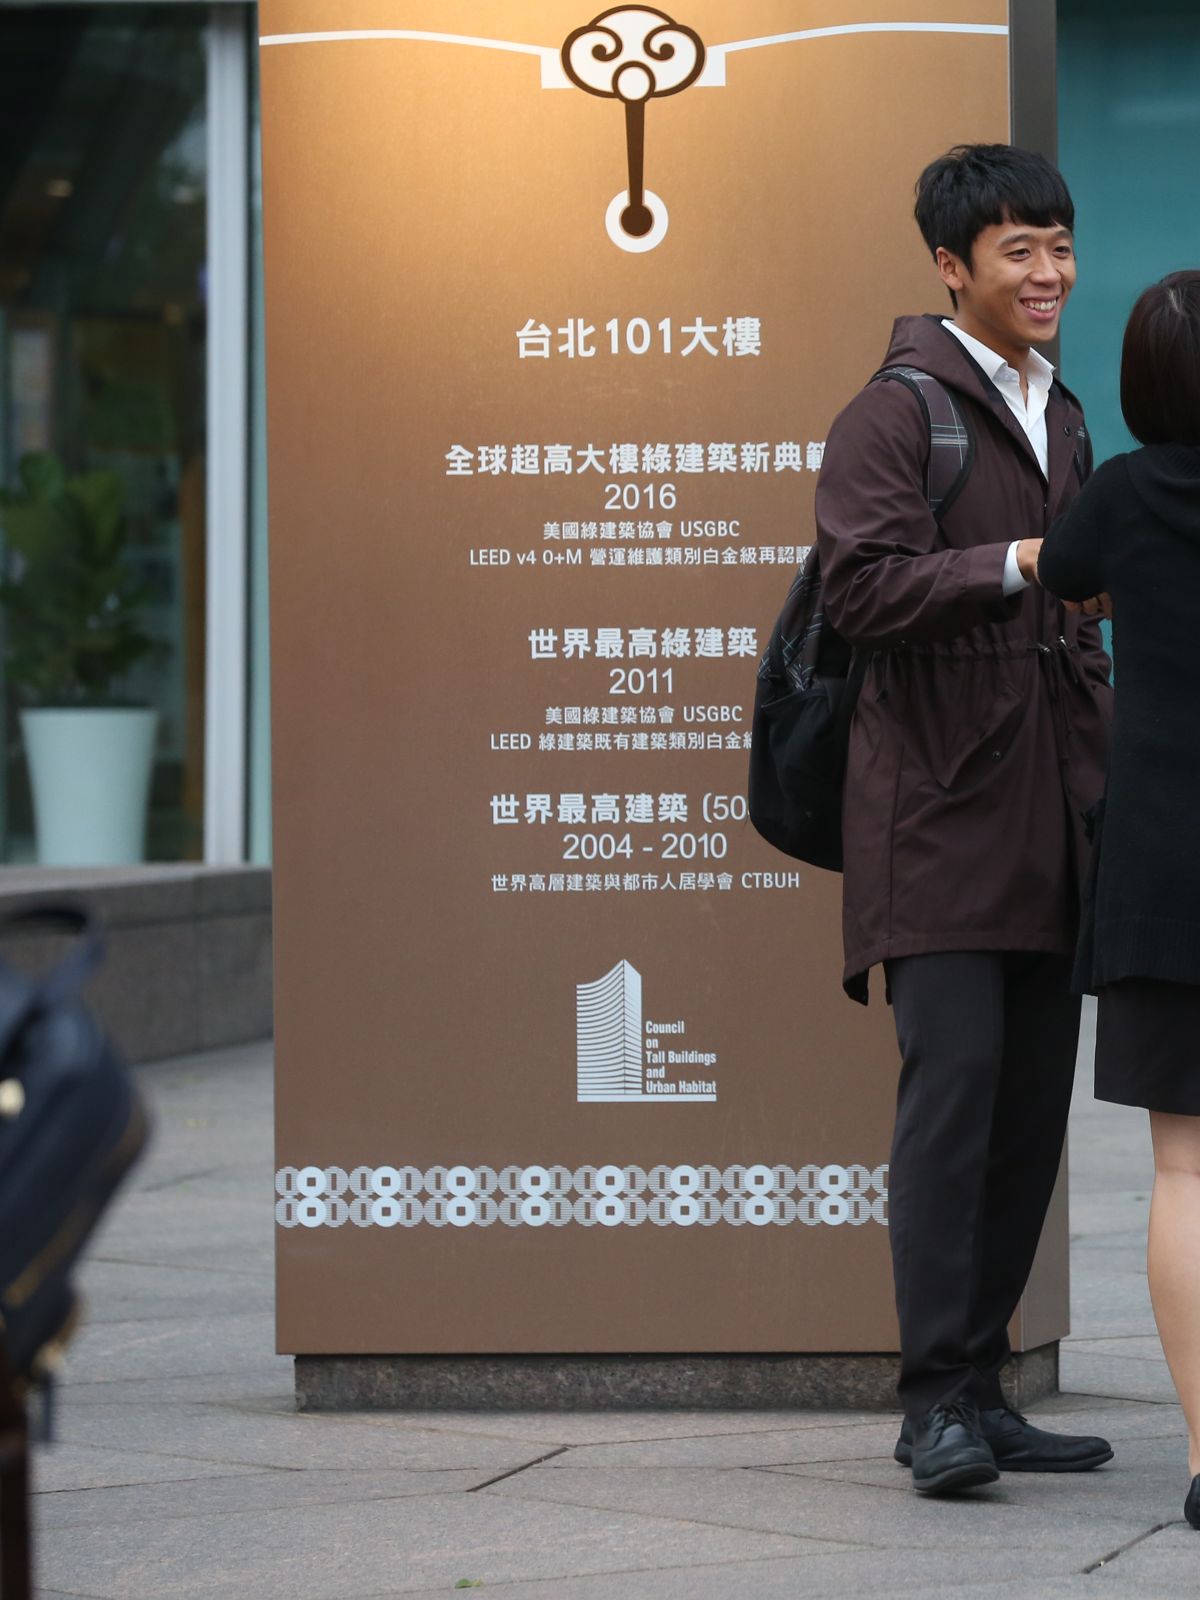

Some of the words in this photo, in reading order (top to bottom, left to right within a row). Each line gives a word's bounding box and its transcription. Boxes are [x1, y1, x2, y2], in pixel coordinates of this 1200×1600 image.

[515, 316, 762, 359] 台北101大樓
[604, 482, 677, 511] 2016
[543, 520, 673, 540] 美國綠建築協會
[680, 519, 740, 538] USGBC
[469, 548, 511, 567] LEED
[516, 549, 537, 567] v4
[528, 626, 758, 659] 世界最高綠建築
[608, 667, 673, 695] 2011
[545, 705, 675, 725] 美國綠建築協會
[683, 705, 743, 723] USGBC
[490, 732, 532, 750] LEED
[489, 792, 688, 825] 世界最高建築
[702, 792, 750, 824] (50
[562, 832, 634, 860] 2004
[661, 832, 728, 860] 2010
[490, 871, 733, 892] 世界高層建築與都市人居學會
[741, 871, 800, 889] CTBUH
[645, 1020, 685, 1034] Council
[645, 1038, 659, 1050] on
[645, 1050, 665, 1064] Tall
[668, 1050, 716, 1066] Buildings
[646, 1065, 666, 1079] and
[646, 1080, 676, 1093] Urban
[679, 1080, 717, 1093] Habitat
